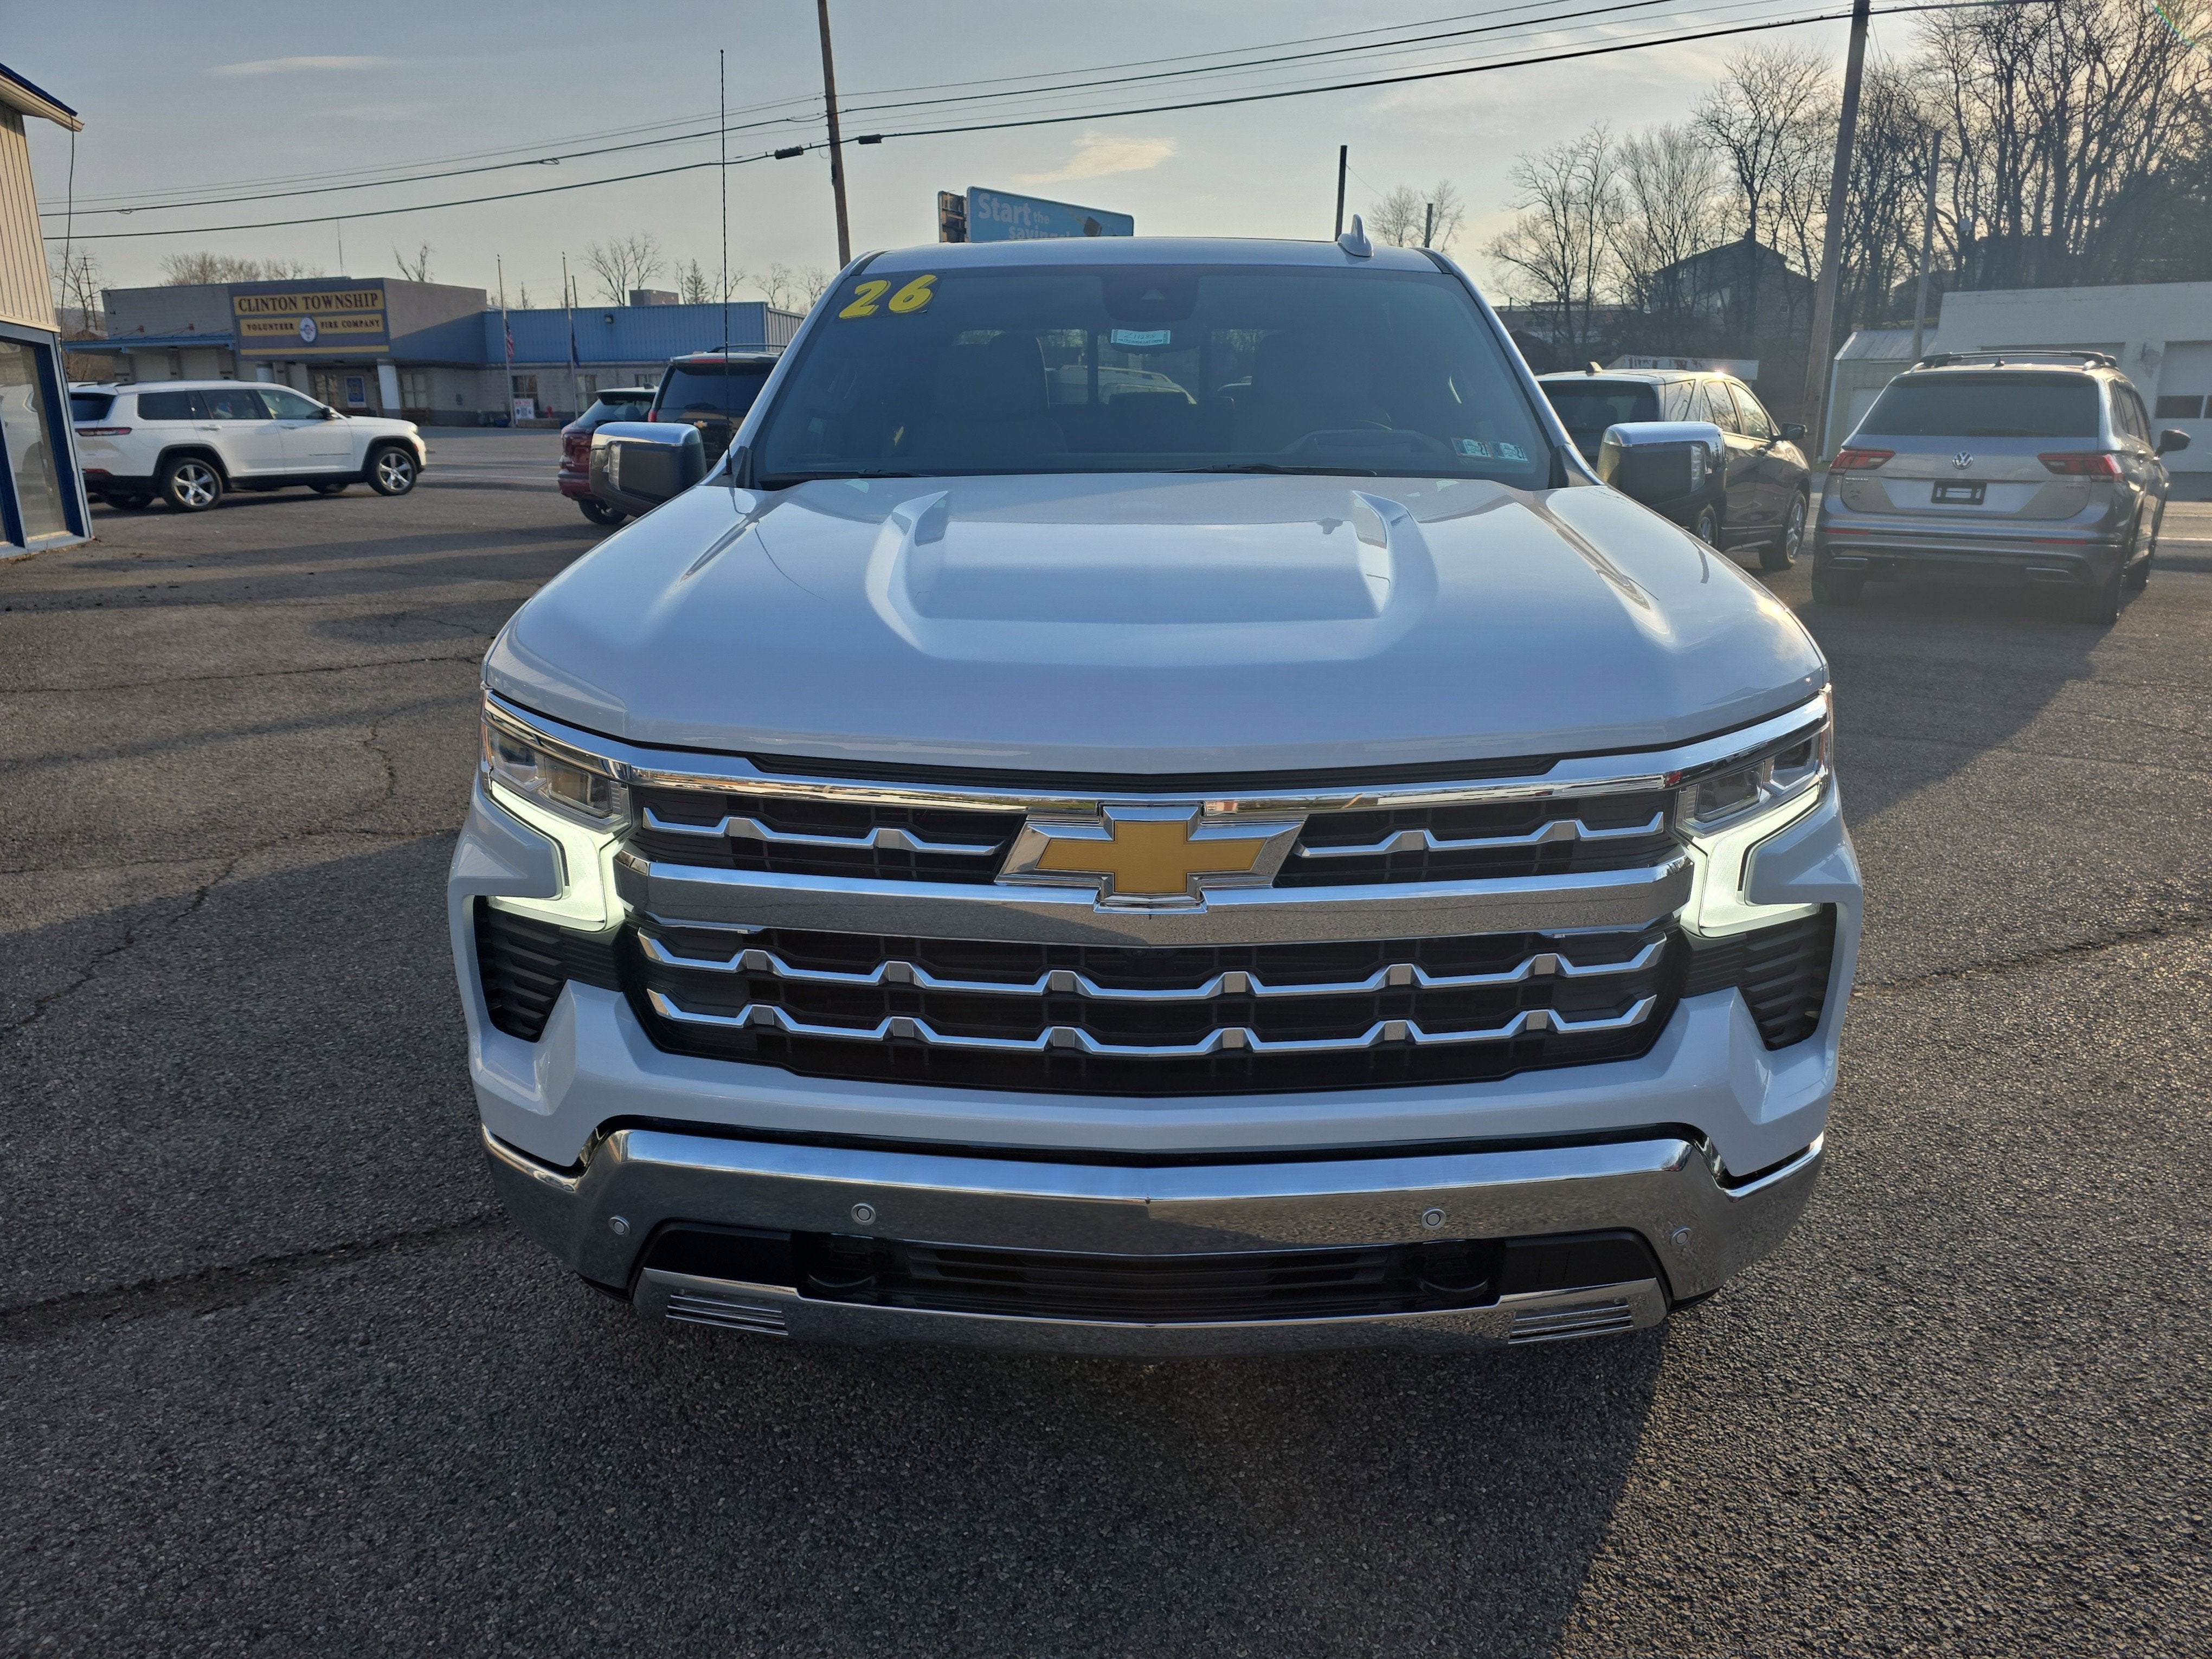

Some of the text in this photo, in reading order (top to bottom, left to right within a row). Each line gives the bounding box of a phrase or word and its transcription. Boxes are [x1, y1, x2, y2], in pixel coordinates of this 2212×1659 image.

[978, 193, 1050, 226] Start the
[239, 293, 378, 313] CLINTON TOWNSHIP
[839, 274, 938, 319] 26
[247, 323, 294, 332] VOLUNTEER
[320, 319, 380, 329] FIRE COMPANY
